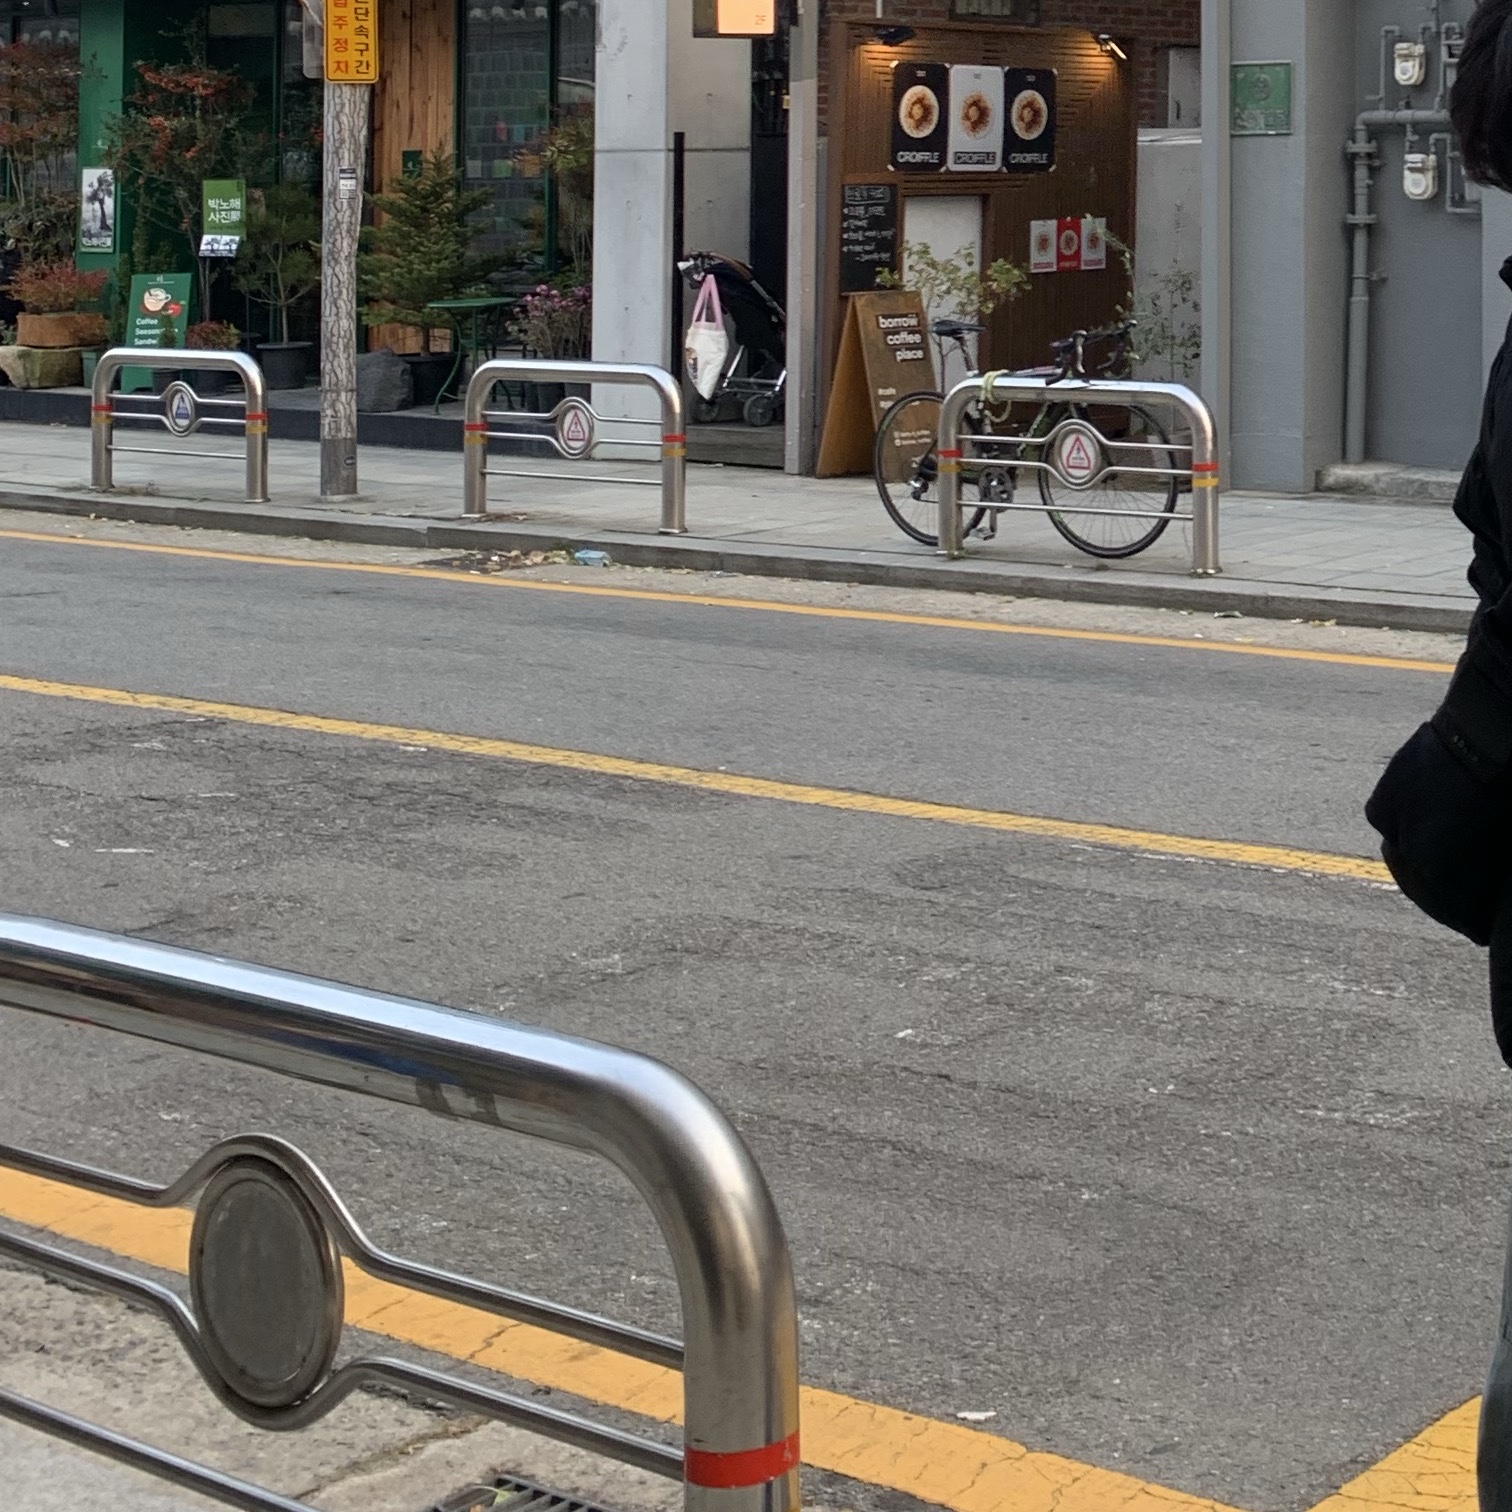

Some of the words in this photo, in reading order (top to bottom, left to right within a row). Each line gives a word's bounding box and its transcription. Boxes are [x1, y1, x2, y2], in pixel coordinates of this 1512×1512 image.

[208, 198, 241, 211] 박노해
[135, 318, 159, 326] Coffee
[886, 331, 923, 345] coffee
[895, 349, 925, 362] place
